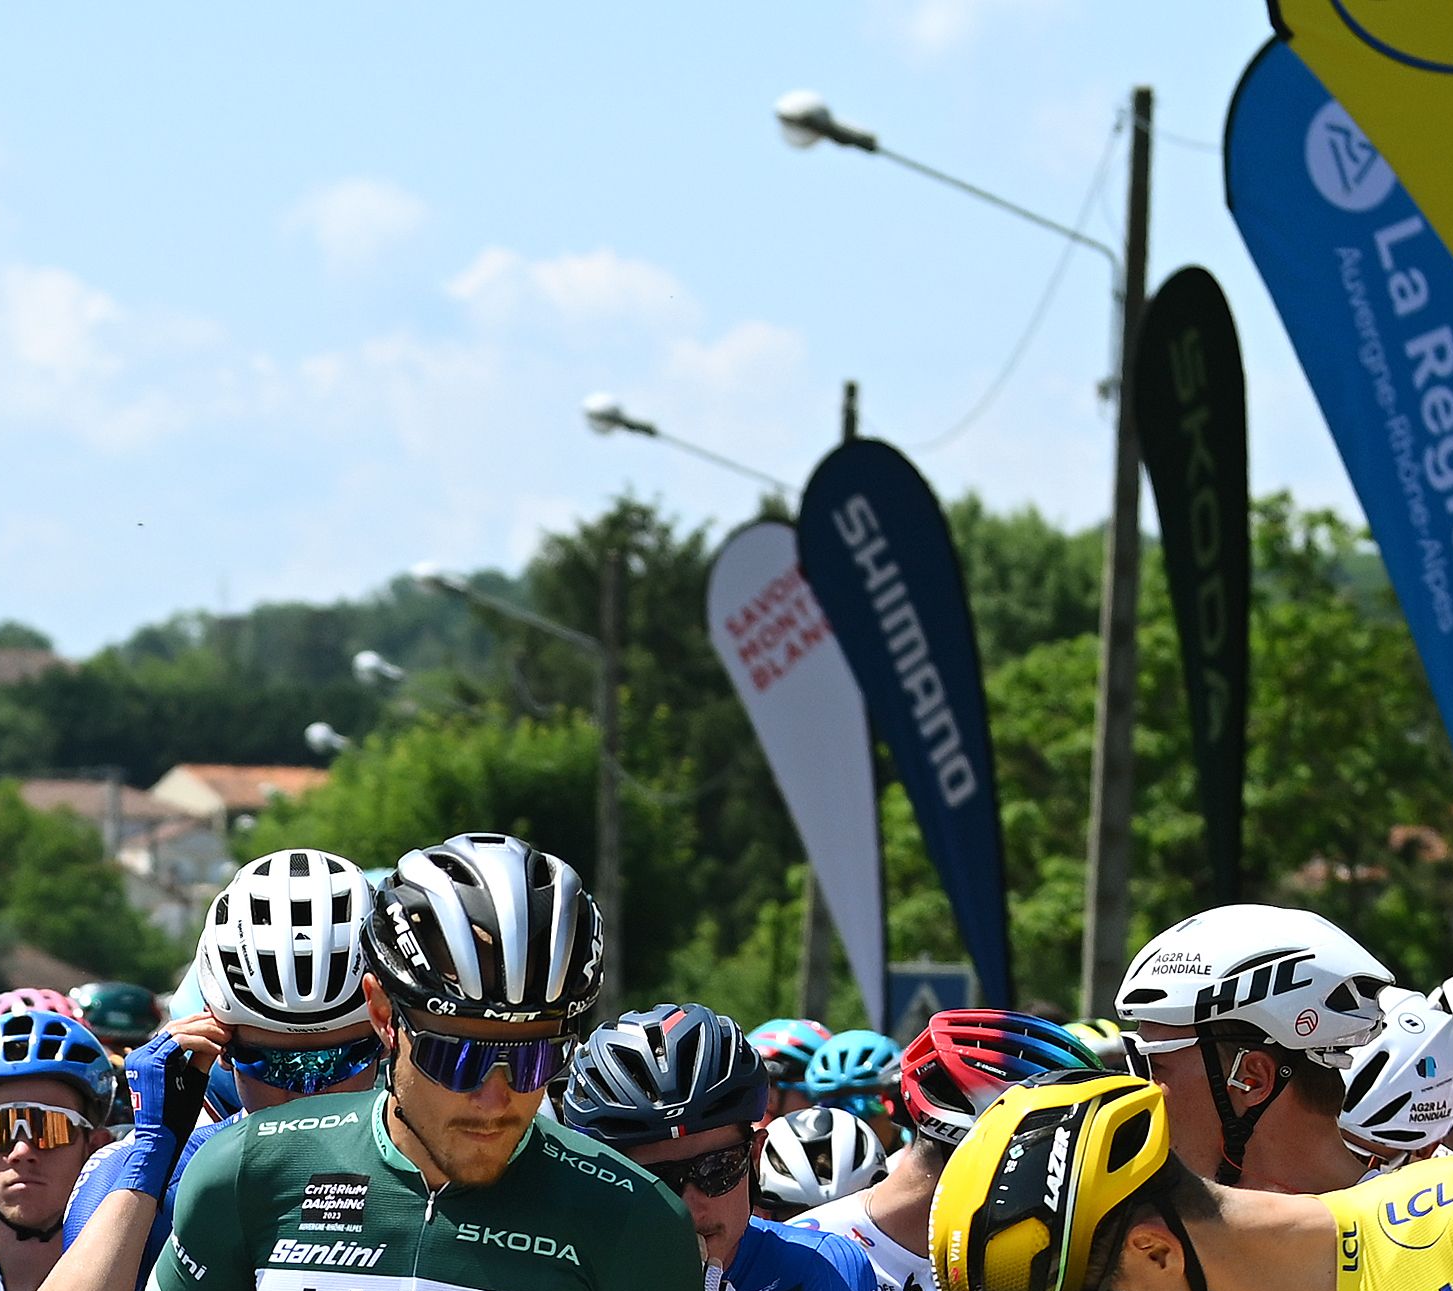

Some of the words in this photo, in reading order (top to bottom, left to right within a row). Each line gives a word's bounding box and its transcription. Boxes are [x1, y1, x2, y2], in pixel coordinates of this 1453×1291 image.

[1374, 216, 1434, 319] La
[833, 494, 978, 809] SHIMANO
[384, 901, 432, 972] MET
[1151, 964, 1212, 976] MONDIALE
[1154, 953, 1182, 964] AG2R
[1186, 952, 1201, 963] LA
[1195, 954, 1317, 1024] HJC
[1044, 1126, 1070, 1212] LAZER
[268, 1239, 388, 1268] Santini
[1343, 1221, 1358, 1272] LCL
